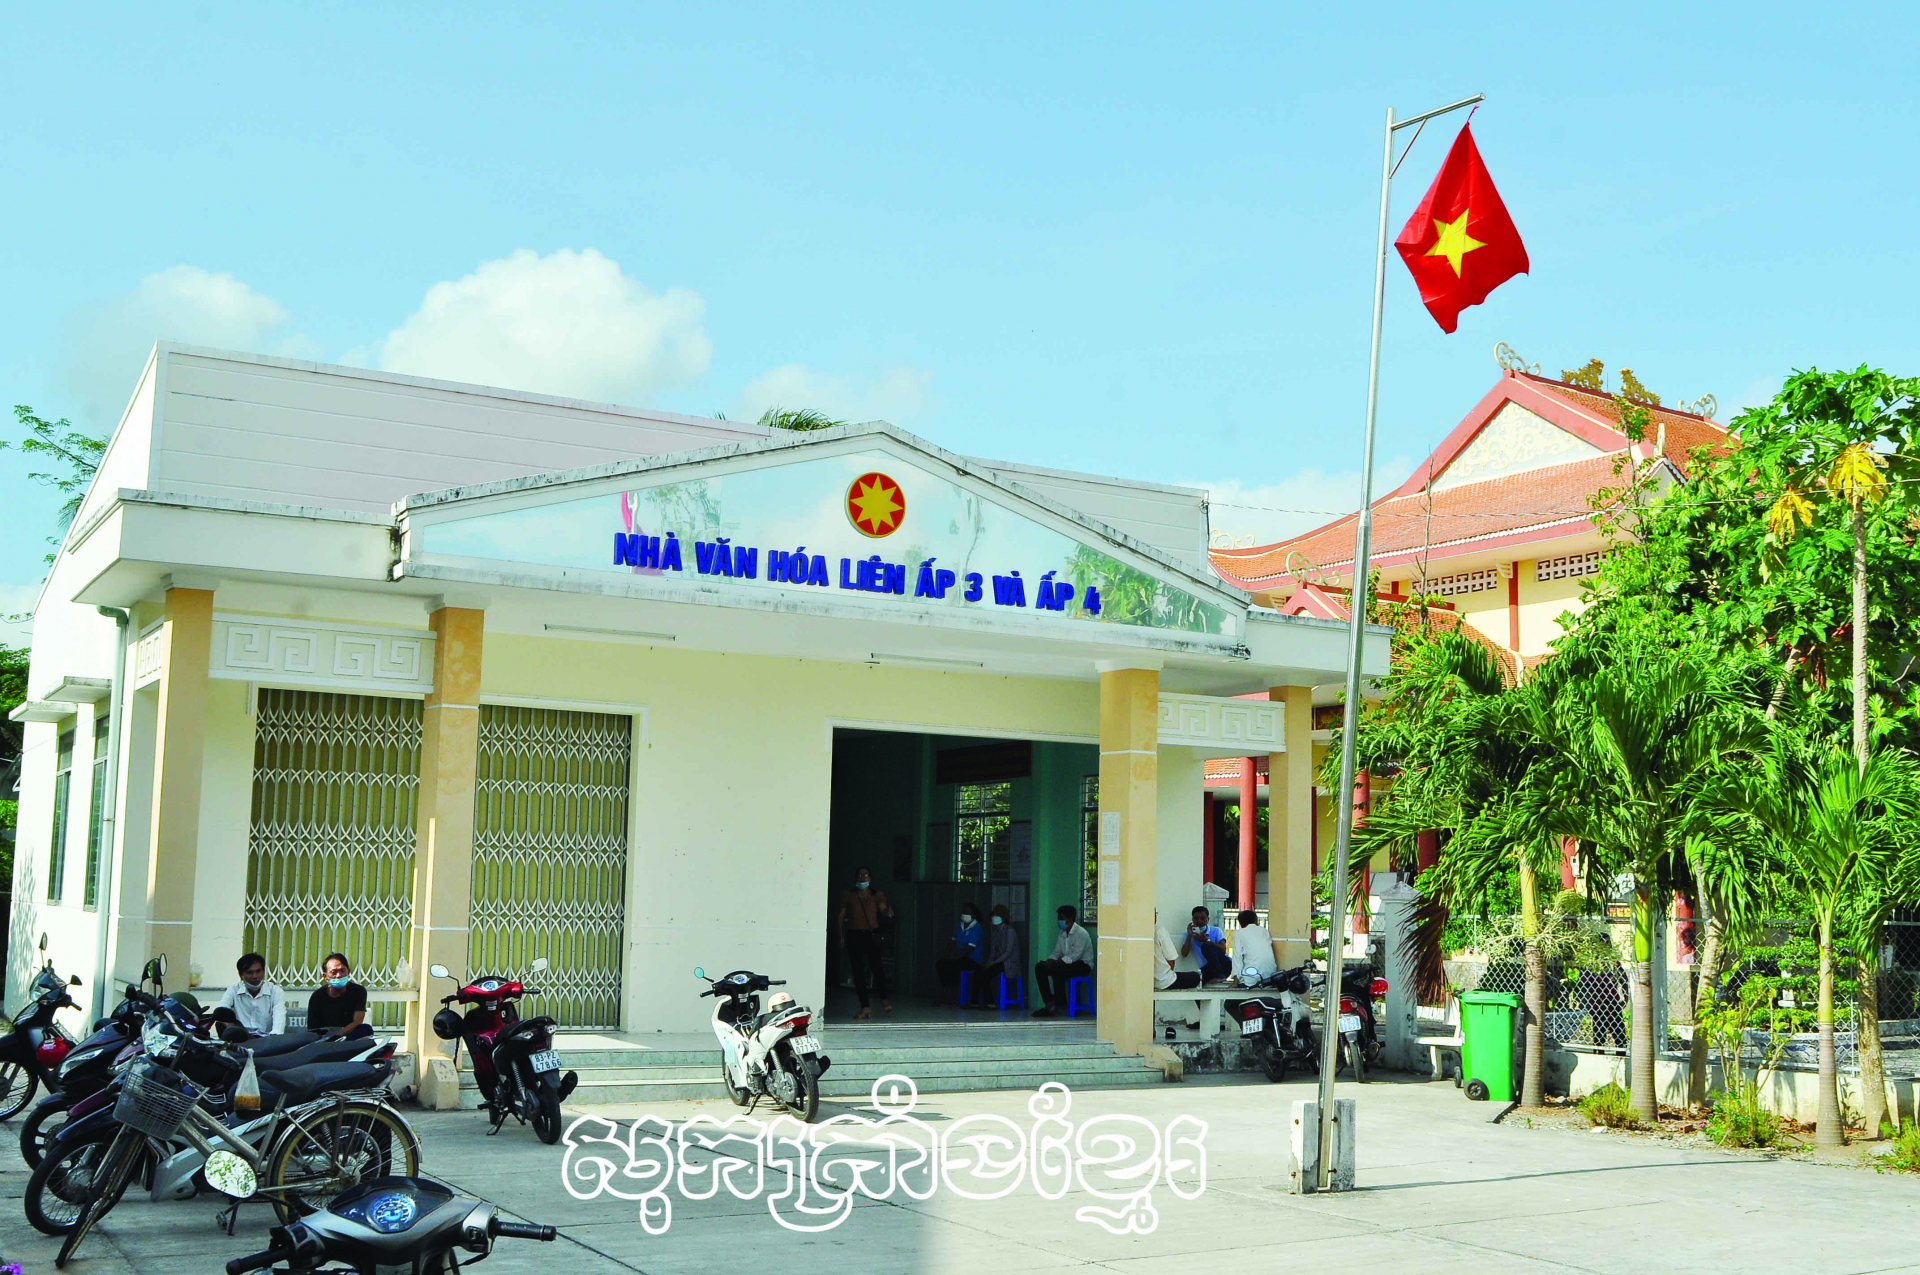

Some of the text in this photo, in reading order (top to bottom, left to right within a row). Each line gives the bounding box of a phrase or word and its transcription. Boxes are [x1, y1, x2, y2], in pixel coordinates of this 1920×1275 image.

[613, 531, 1102, 615] NHÀ VĂN HÓA LIÊN ẤP 3 VÀ ẤP 4
[289, 1016, 307, 1027] HU
